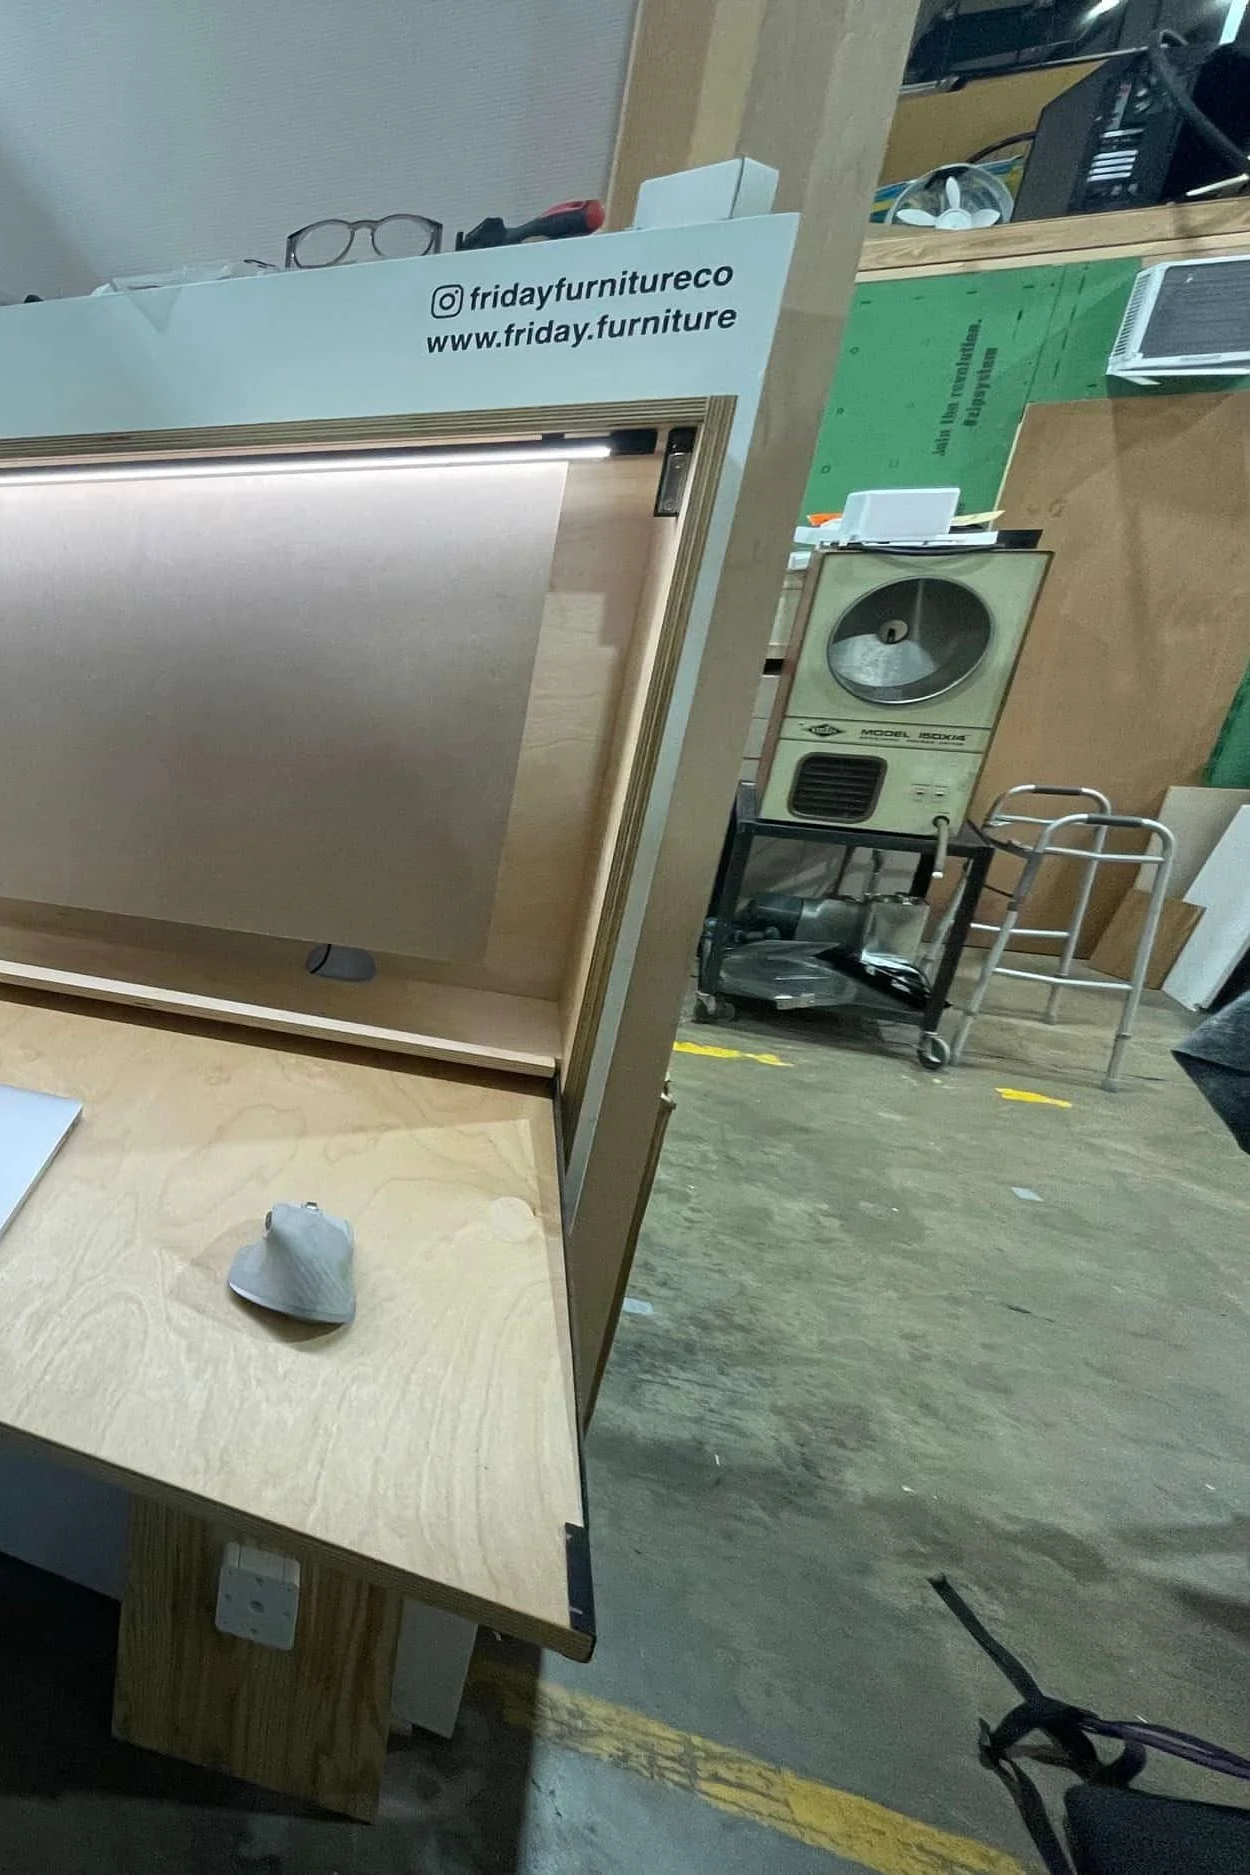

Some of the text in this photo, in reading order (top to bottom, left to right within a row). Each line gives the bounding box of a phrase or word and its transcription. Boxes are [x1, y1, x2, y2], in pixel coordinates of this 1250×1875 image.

[470, 264, 734, 312] fridayfurnitureco
[426, 307, 738, 354] www.friday.furniture
[861, 728, 910, 738] MODEL
